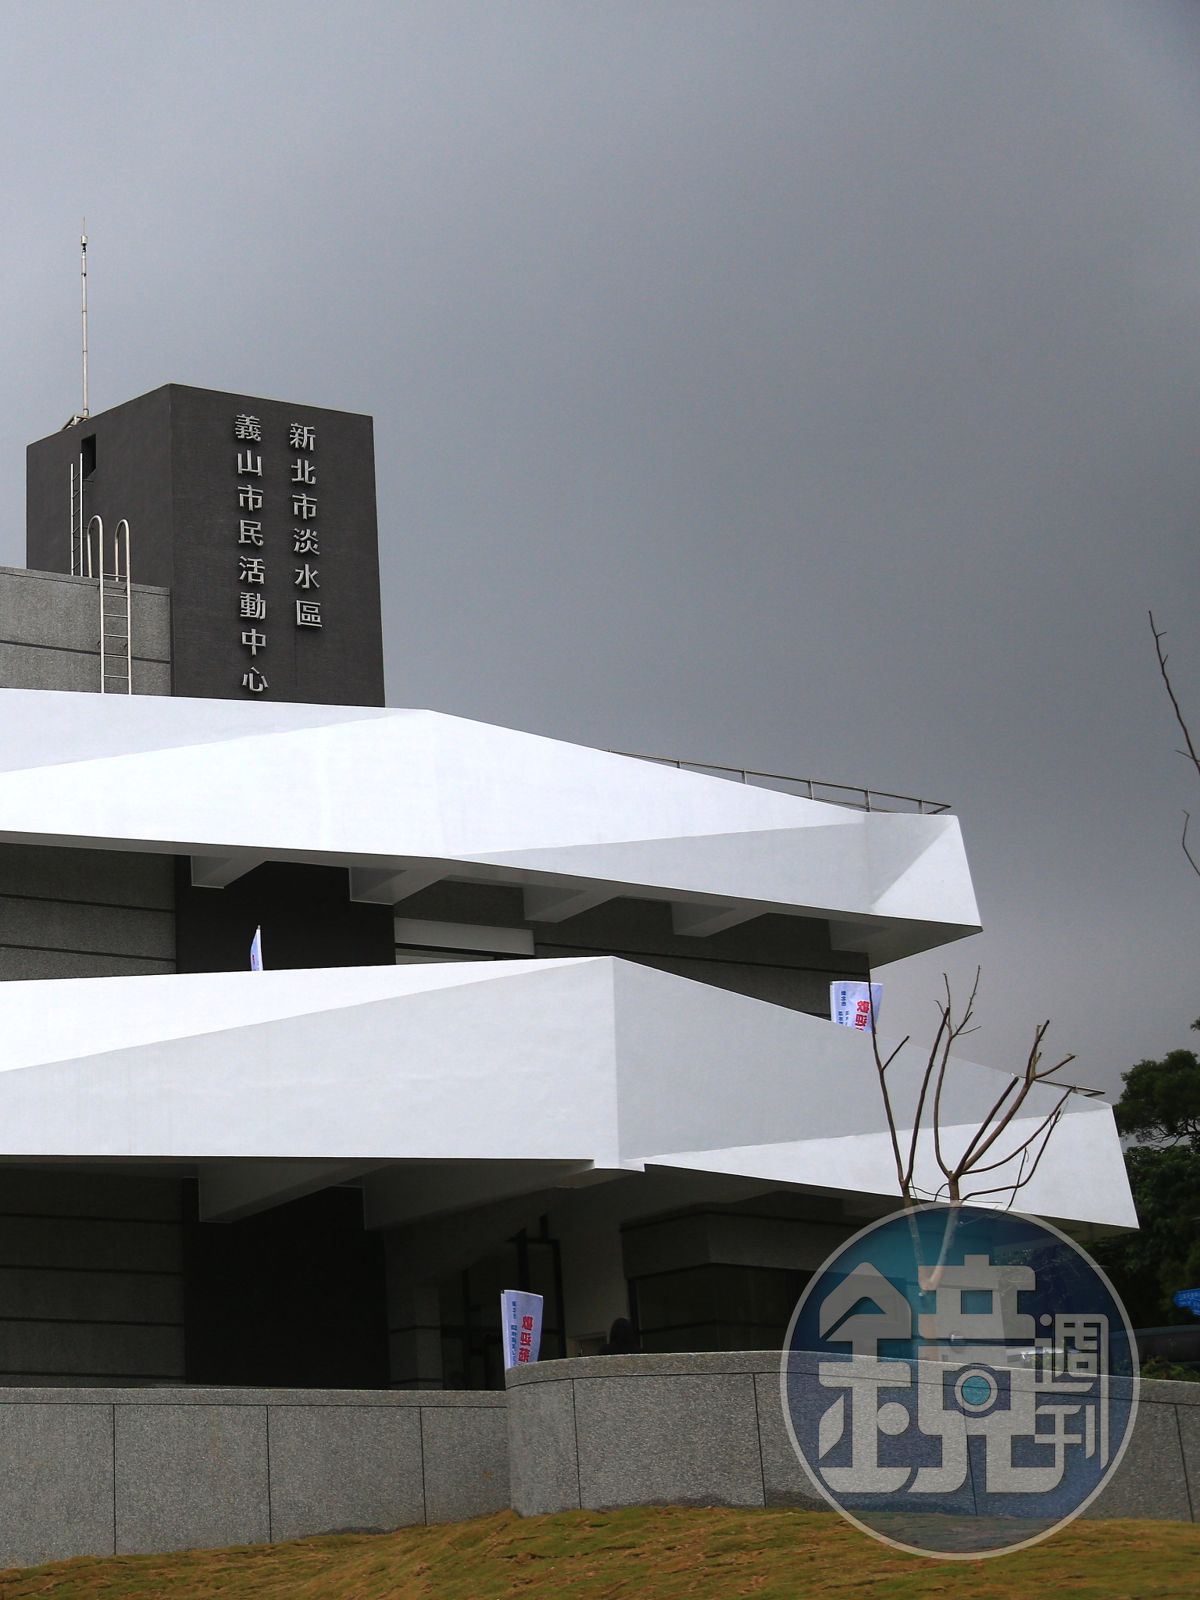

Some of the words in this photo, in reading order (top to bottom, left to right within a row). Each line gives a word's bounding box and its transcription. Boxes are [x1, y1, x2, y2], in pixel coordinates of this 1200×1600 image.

[234, 413, 269, 692] 義山市民活動中心
[289, 422, 323, 628] 新北市淡水區
